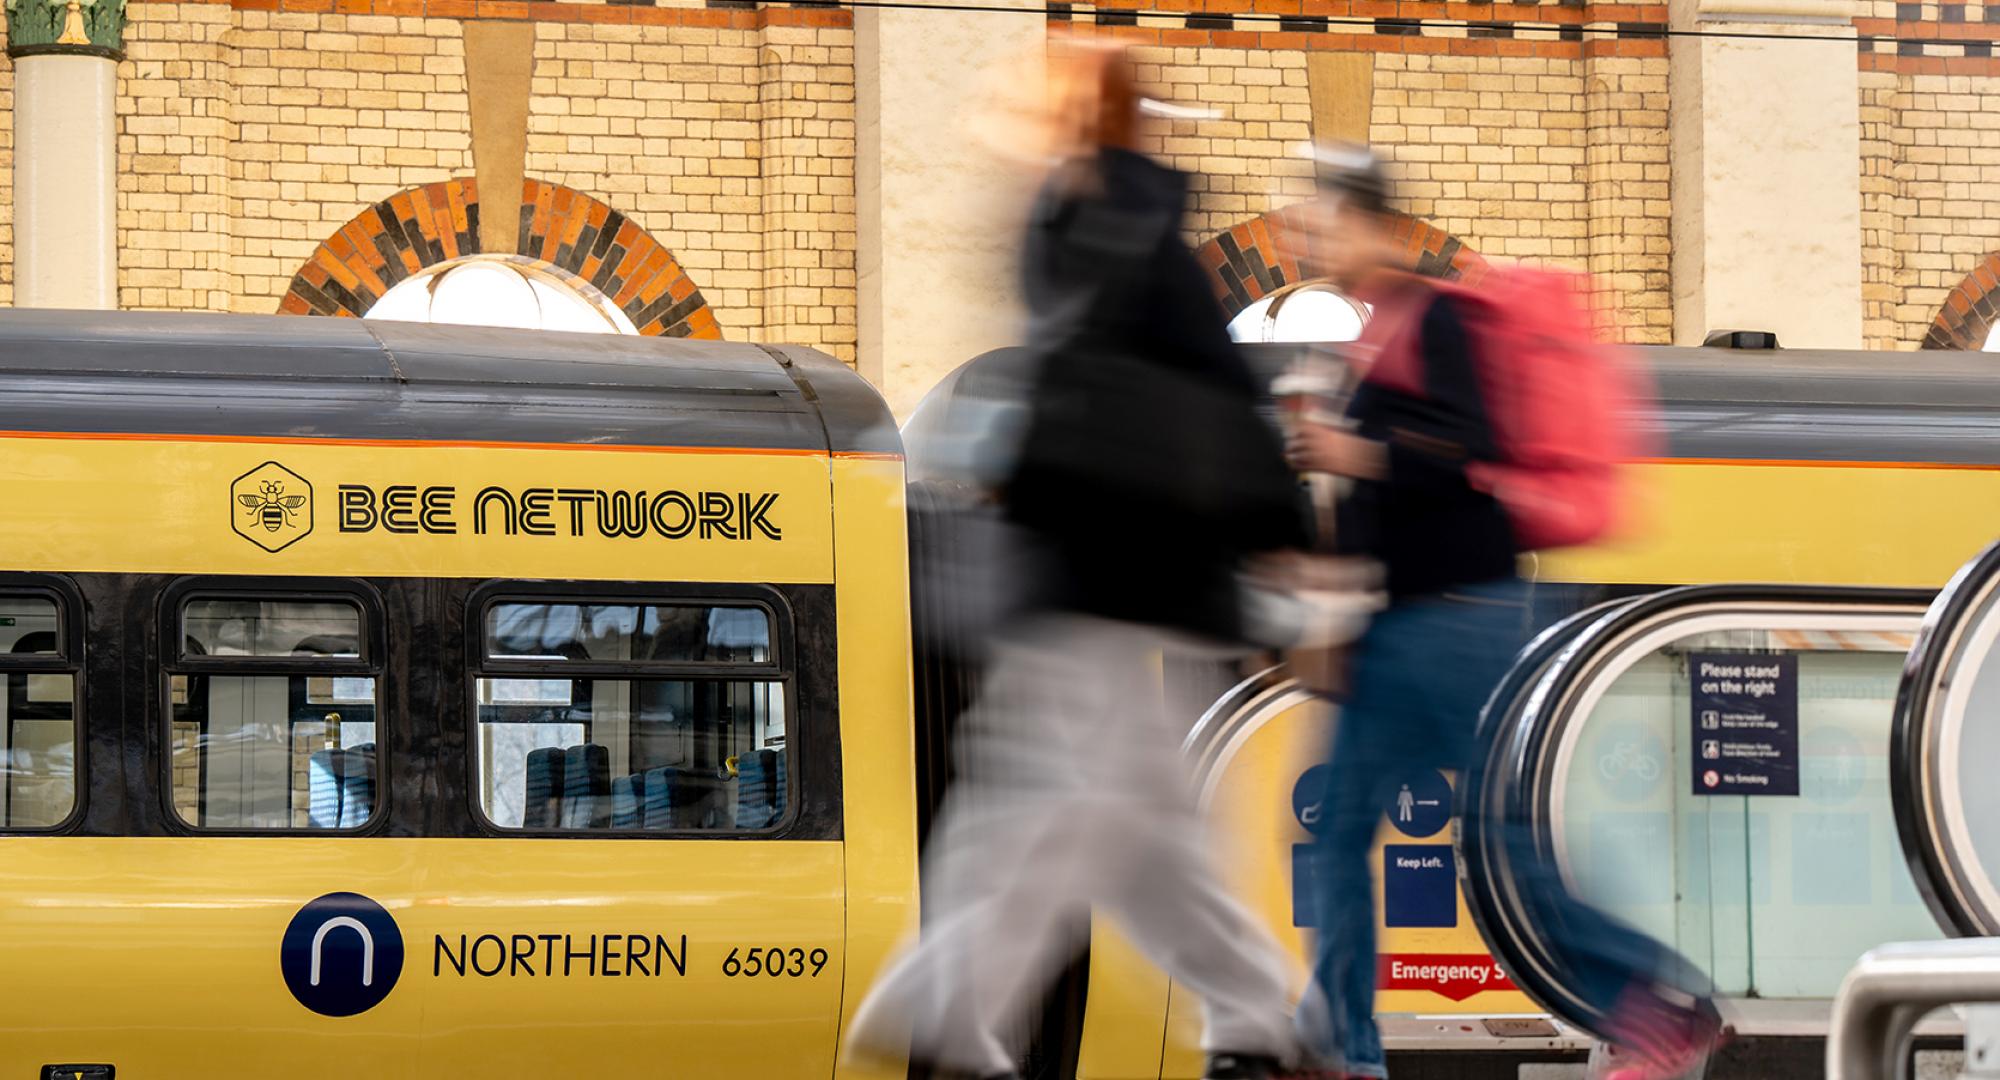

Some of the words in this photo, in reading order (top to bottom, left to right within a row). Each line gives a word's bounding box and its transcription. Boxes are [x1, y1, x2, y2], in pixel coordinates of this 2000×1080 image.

[338, 484, 457, 535] BEE
[473, 485, 782, 541] NETWORK
[1700, 662, 1742, 678] Please
[1743, 664, 1780, 679] stand
[1700, 682, 1719, 694] on
[1720, 679, 1743, 694] the
[1744, 680, 1776, 698] right
[1723, 774, 1735, 784] No
[1735, 773, 1769, 786] Smoking
[1396, 857, 1422, 870] Keep
[1422, 856, 1444, 868] Left.
[433, 934, 687, 977] NORTHERN
[722, 947, 829, 978] 65039
[1391, 961, 1490, 984] Emergency
